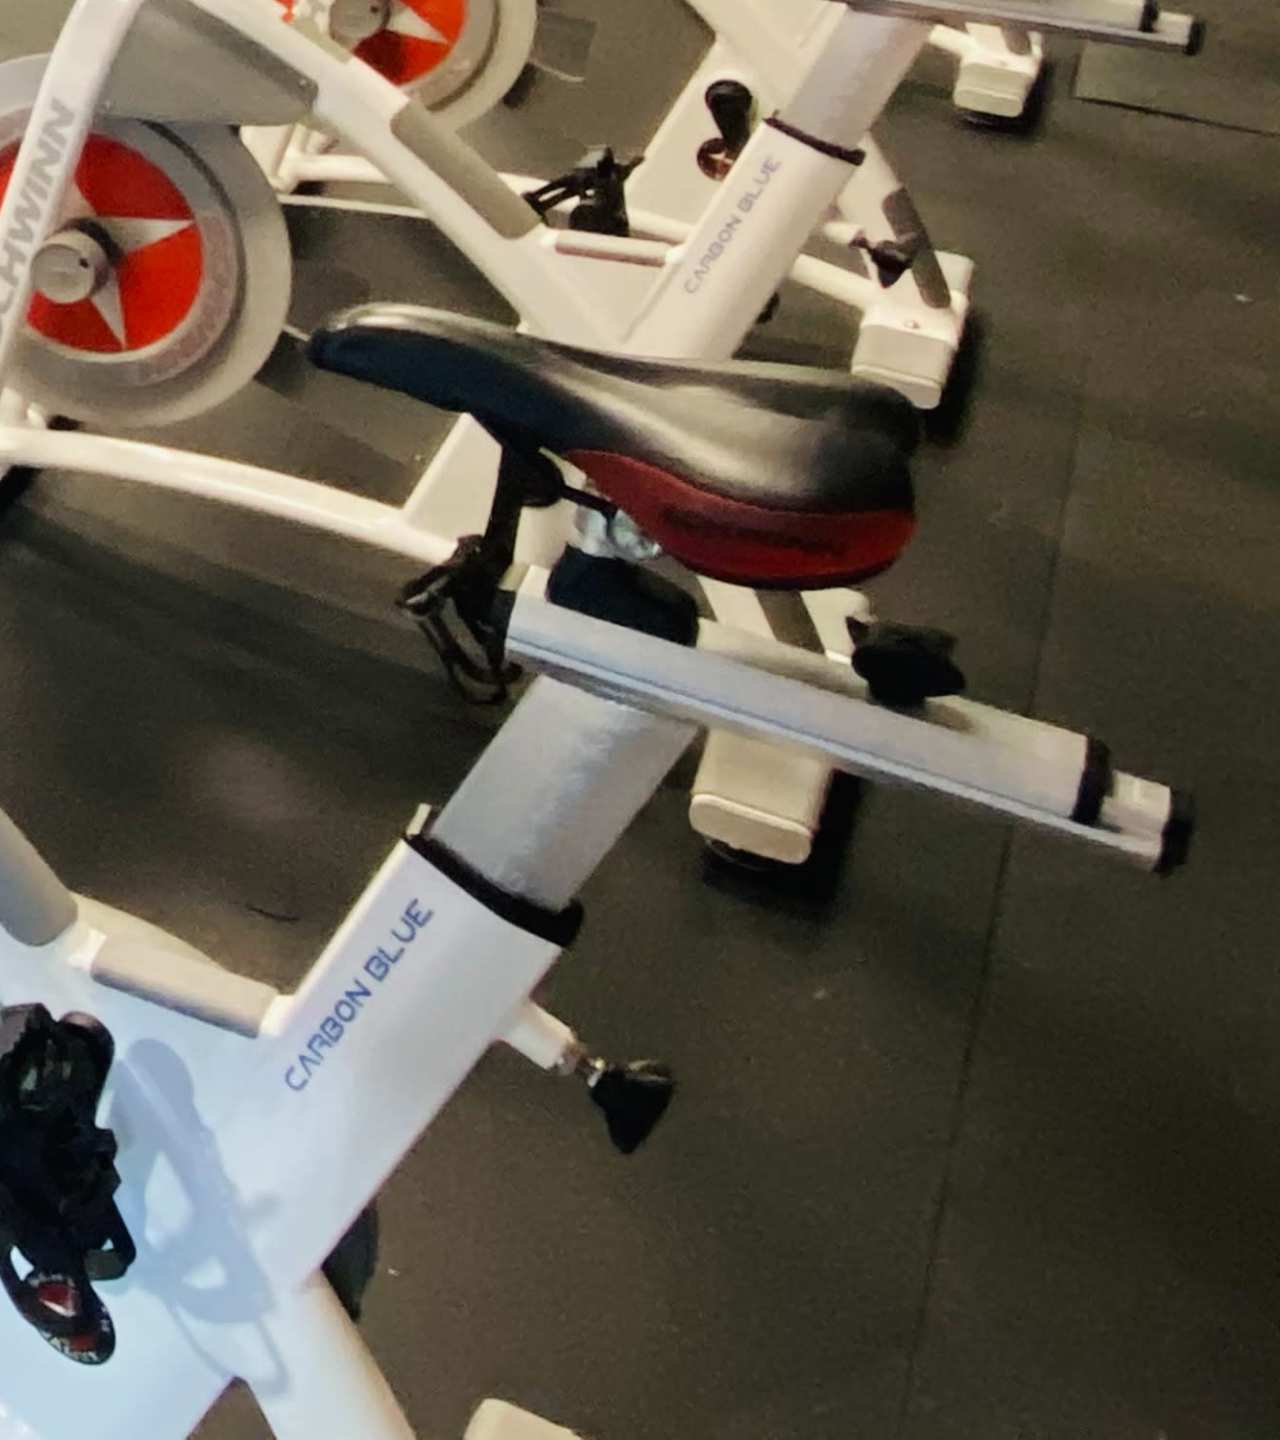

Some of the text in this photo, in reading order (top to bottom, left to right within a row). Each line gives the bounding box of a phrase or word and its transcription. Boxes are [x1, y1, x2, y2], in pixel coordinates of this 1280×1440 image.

[683, 157, 783, 295] CARBON BLUE
[284, 897, 436, 1092] CARBON BLUE
